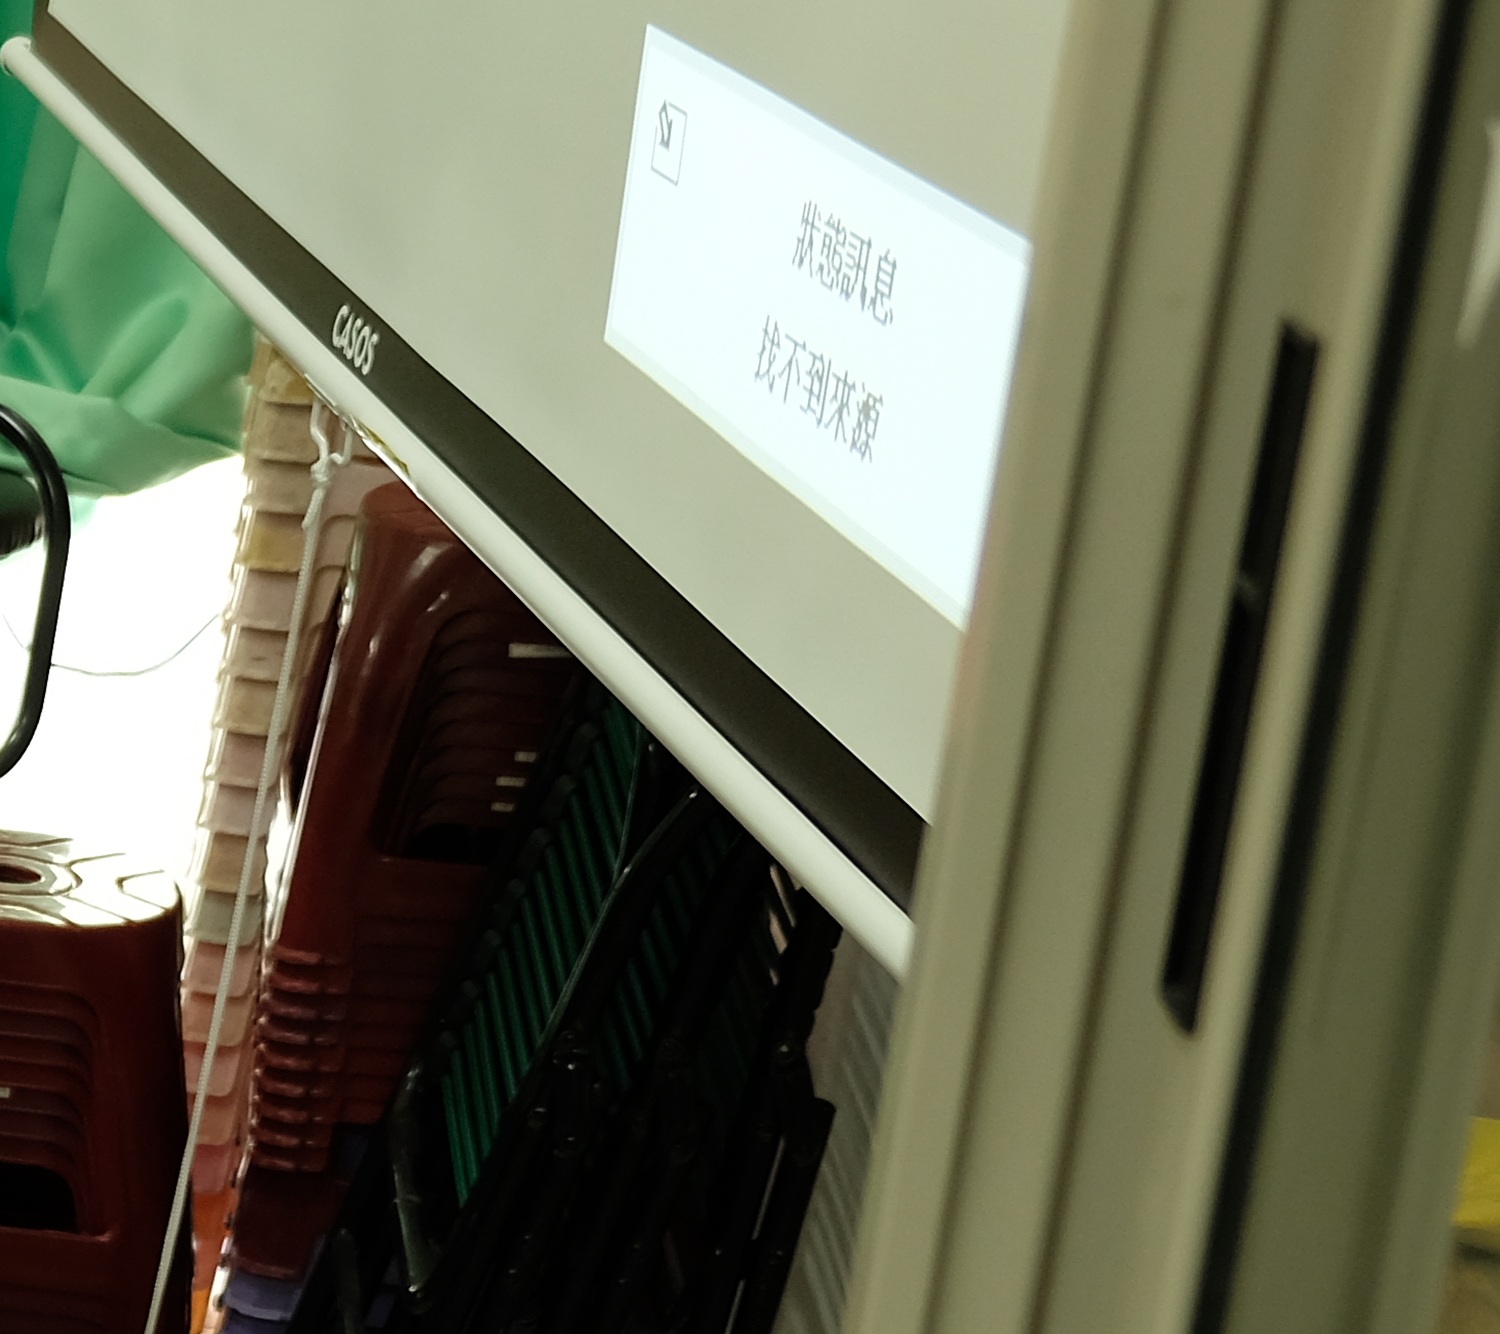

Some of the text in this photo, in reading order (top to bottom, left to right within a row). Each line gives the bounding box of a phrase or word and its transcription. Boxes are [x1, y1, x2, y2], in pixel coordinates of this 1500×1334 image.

[791, 199, 898, 327] 狀態訊息
[332, 303, 380, 376] CASOS
[753, 314, 885, 463] 找不到來源
